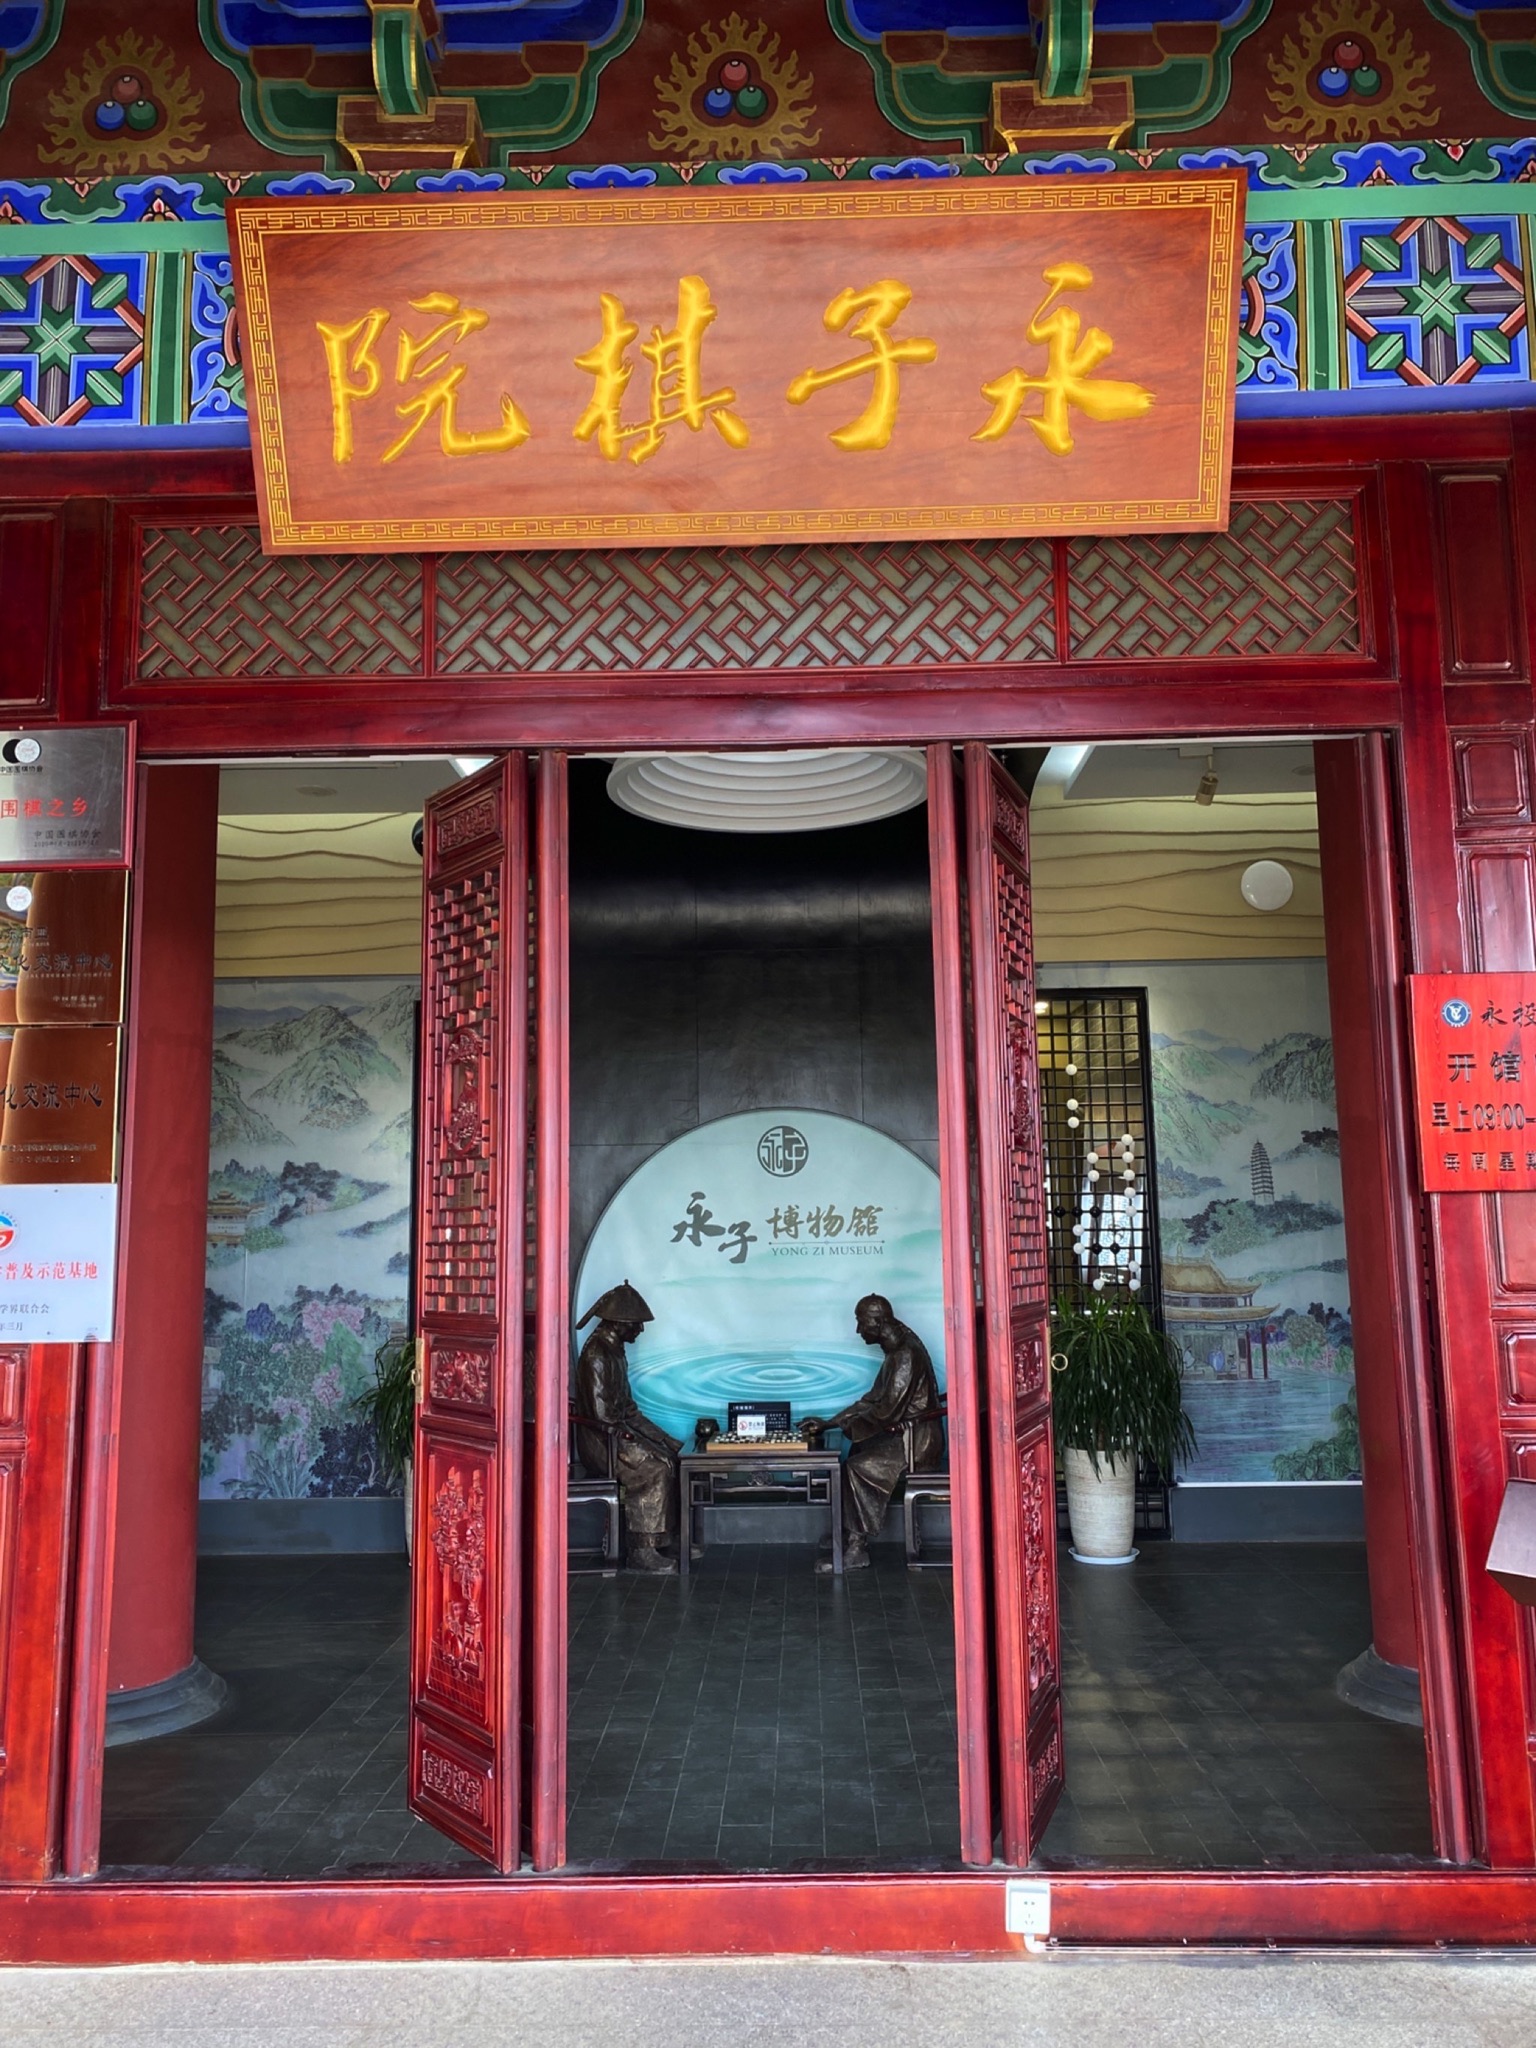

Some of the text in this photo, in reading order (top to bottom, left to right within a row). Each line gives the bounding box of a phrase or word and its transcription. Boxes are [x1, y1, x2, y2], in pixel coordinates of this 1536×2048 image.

[314, 261, 1157, 466] 永子棋院
[1, 797, 88, 819] 围棋之乡
[1447, 1051, 1536, 1083] 开馆
[771, 1245, 884, 1256] YONG ZI MUSEUM
[0, 1262, 98, 1280] 普及示范基地
